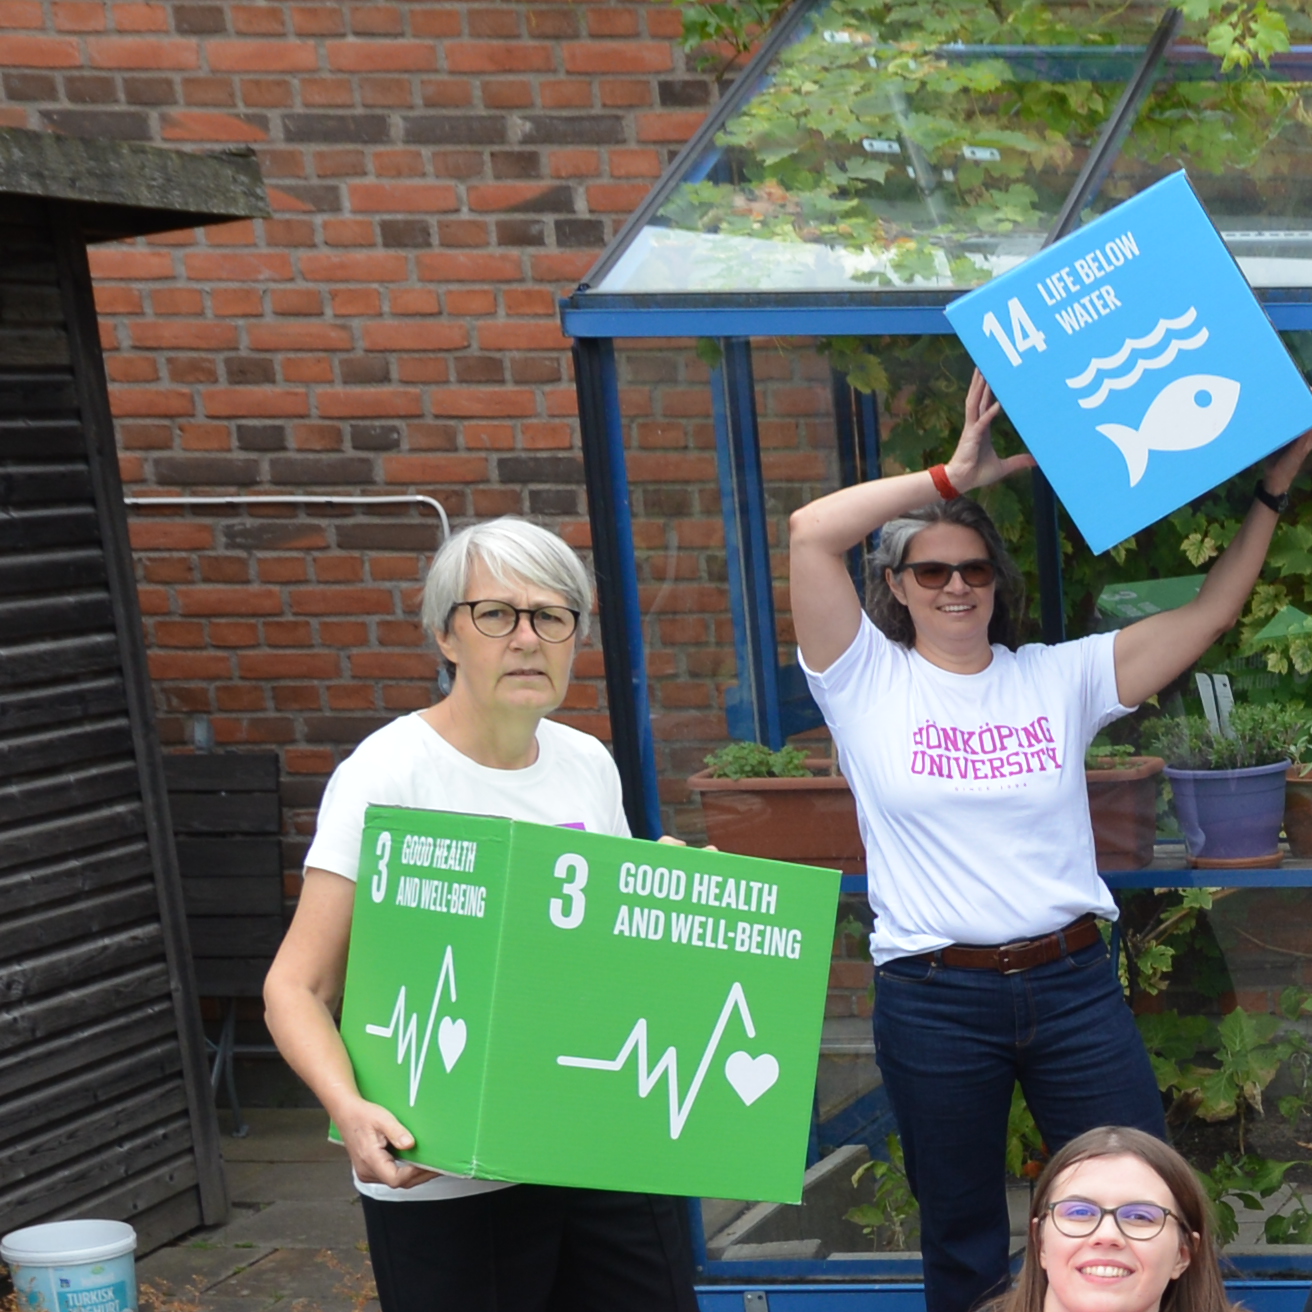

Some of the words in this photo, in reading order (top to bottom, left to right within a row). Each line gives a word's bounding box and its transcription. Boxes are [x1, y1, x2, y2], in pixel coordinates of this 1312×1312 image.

[982, 296, 1048, 367] 14
[1036, 266, 1081, 306] LIFE
[1074, 230, 1140, 286] BELOW
[1054, 284, 1122, 336] WATER
[910, 746, 1063, 781] UNIVERSITY
[370, 830, 393, 903] 3
[400, 833, 433, 869] GOOD
[433, 836, 478, 874] HEALTH
[549, 852, 589, 930] 3
[618, 861, 687, 902] GOOD
[690, 871, 779, 915] HEALTH
[395, 875, 421, 908] AND
[419, 878, 487, 919] WELL-BEING
[613, 904, 666, 942] AND
[669, 908, 803, 961] WELL-BEING
[66, 1286, 115, 1306] TURKISK
